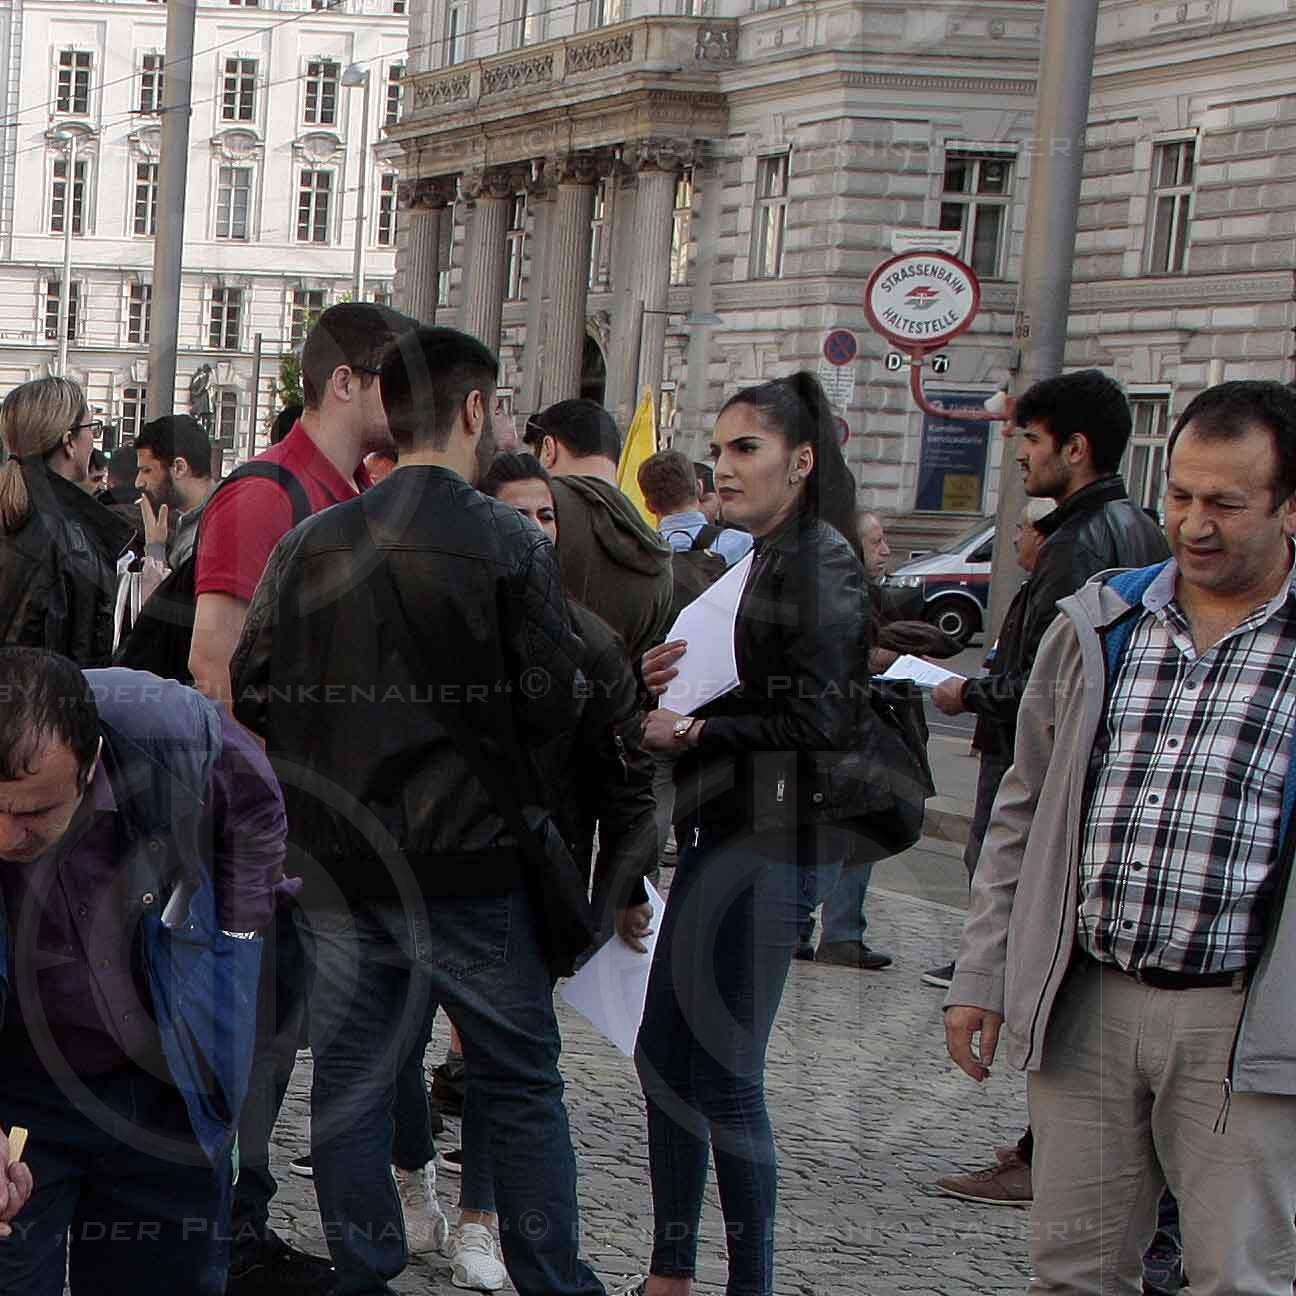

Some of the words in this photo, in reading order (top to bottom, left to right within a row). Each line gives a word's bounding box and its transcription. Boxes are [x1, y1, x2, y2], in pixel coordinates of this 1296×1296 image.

[880, 263, 967, 296] STRASSENBAHN
[881, 306, 962, 335] HALTESTELLE
[887, 356, 900, 370] D
[932, 357, 950, 372] 71
